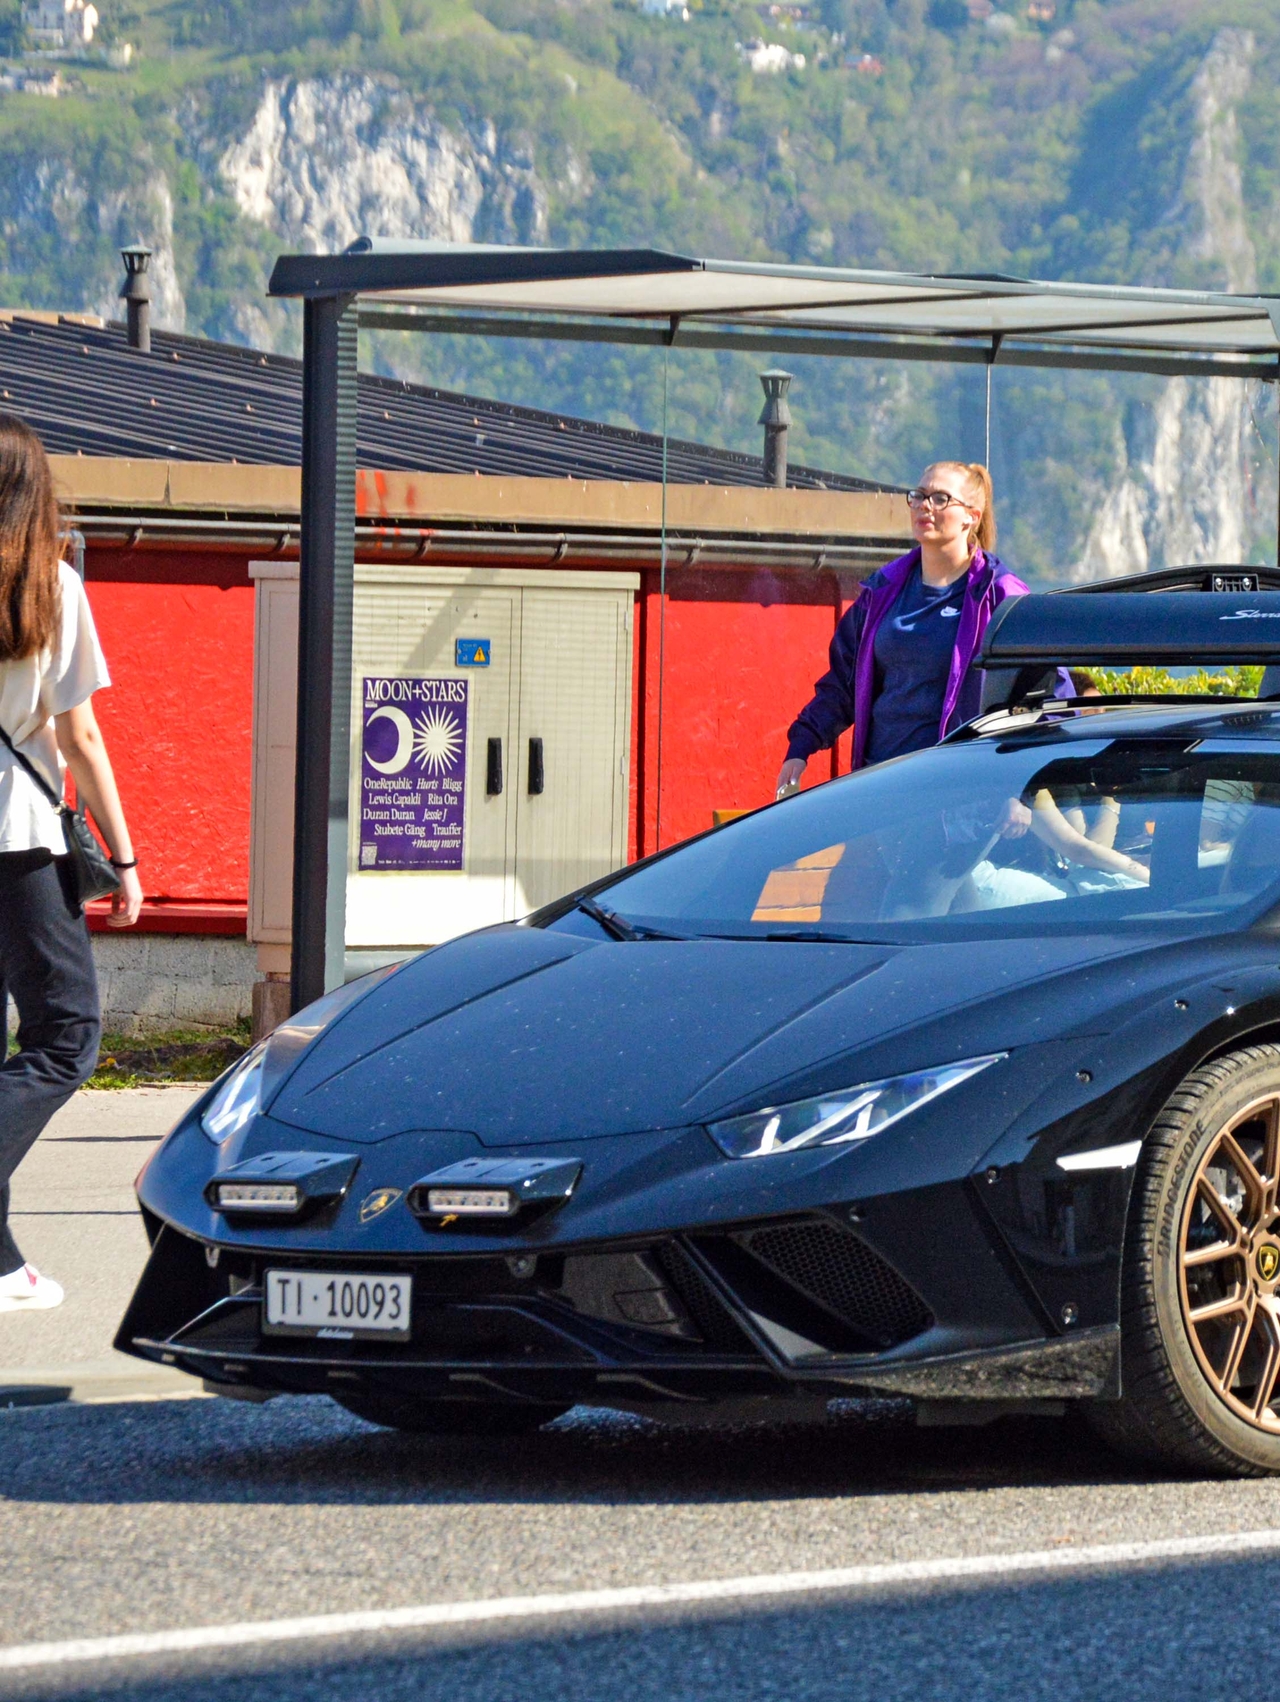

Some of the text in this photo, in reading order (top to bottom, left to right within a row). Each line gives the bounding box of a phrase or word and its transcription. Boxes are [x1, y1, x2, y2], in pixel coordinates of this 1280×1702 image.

[366, 679, 465, 702] MOON+STARS
[363, 777, 463, 792] OneRepublic Hurts Bligg
[368, 793, 458, 808] Lewis Capaldi Rita Ora
[363, 808, 448, 822] Duran Duran Jessie J
[374, 822, 462, 838] Stubete Gäng Trauffer
[411, 839, 461, 852] +many more
[1157, 1119, 1206, 1259] BRIDGESTONE
